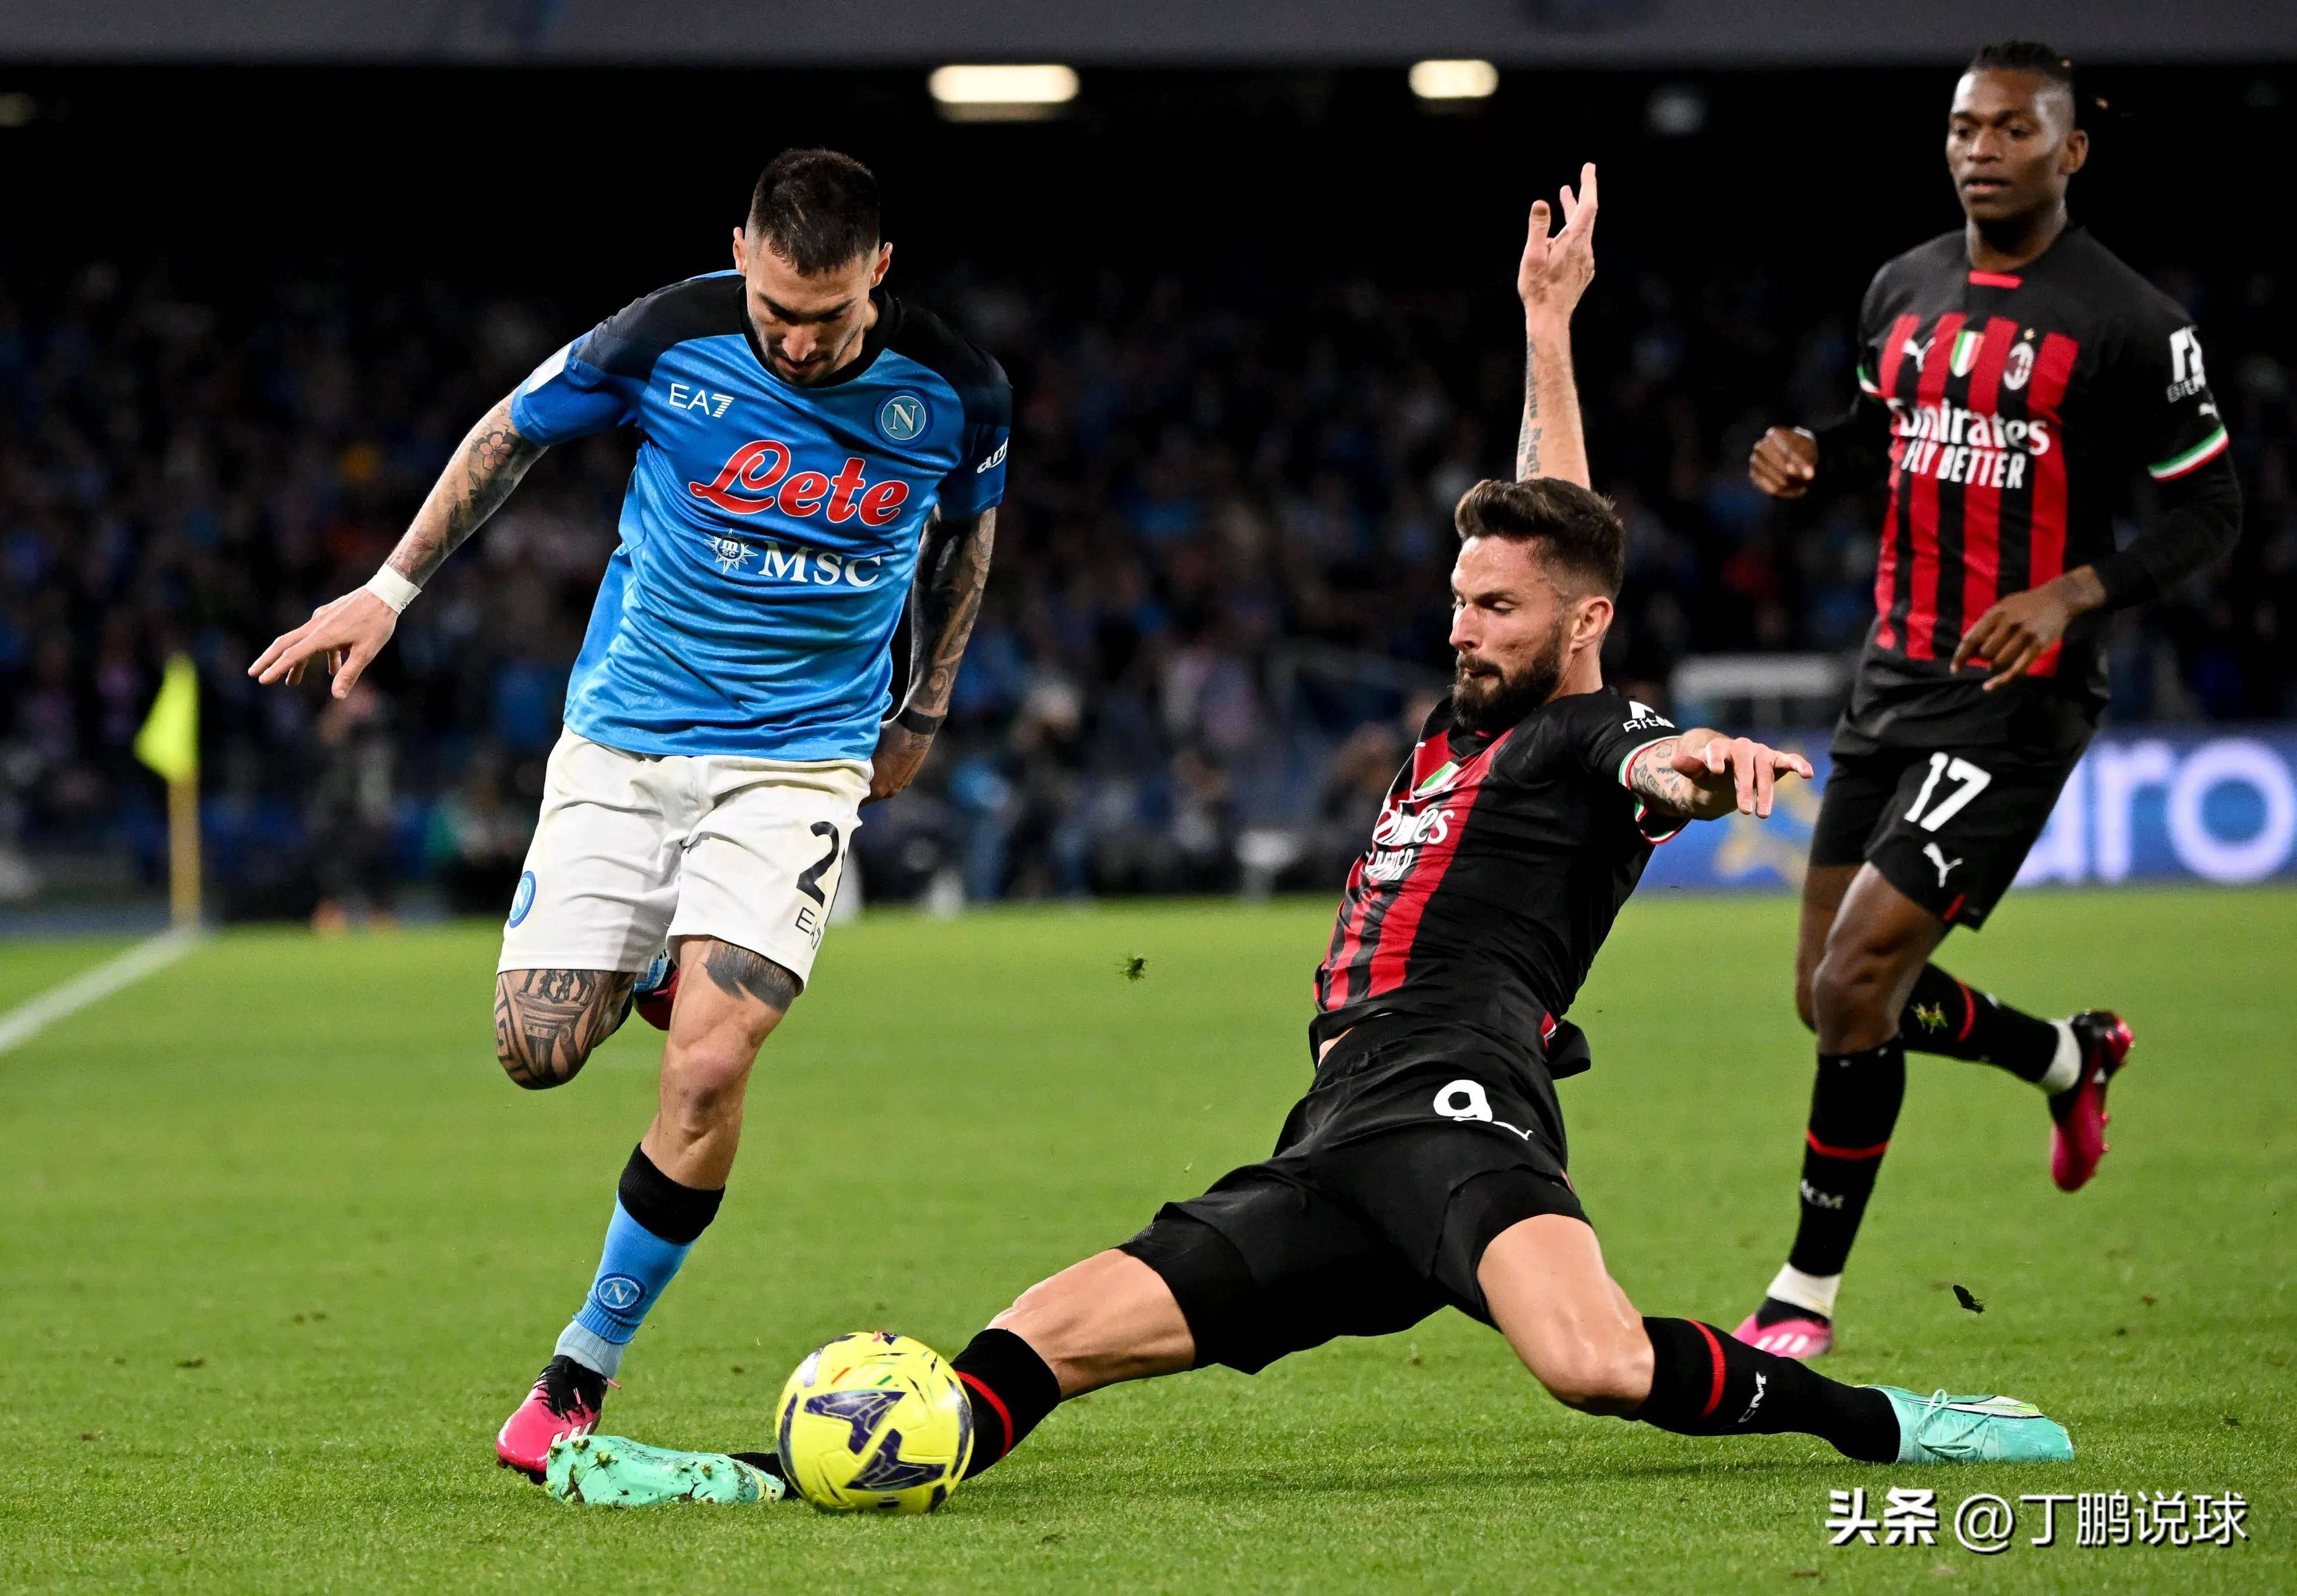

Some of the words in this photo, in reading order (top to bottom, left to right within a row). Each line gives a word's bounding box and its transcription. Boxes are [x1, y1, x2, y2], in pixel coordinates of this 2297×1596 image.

[669, 382, 735, 418] EA7
[889, 403, 918, 432] N
[688, 439, 910, 527] Lete
[1935, 445, 2026, 489] BETTER
[758, 540, 881, 588] MSC
[1905, 752, 1992, 832] 17
[603, 1282, 630, 1304] N
